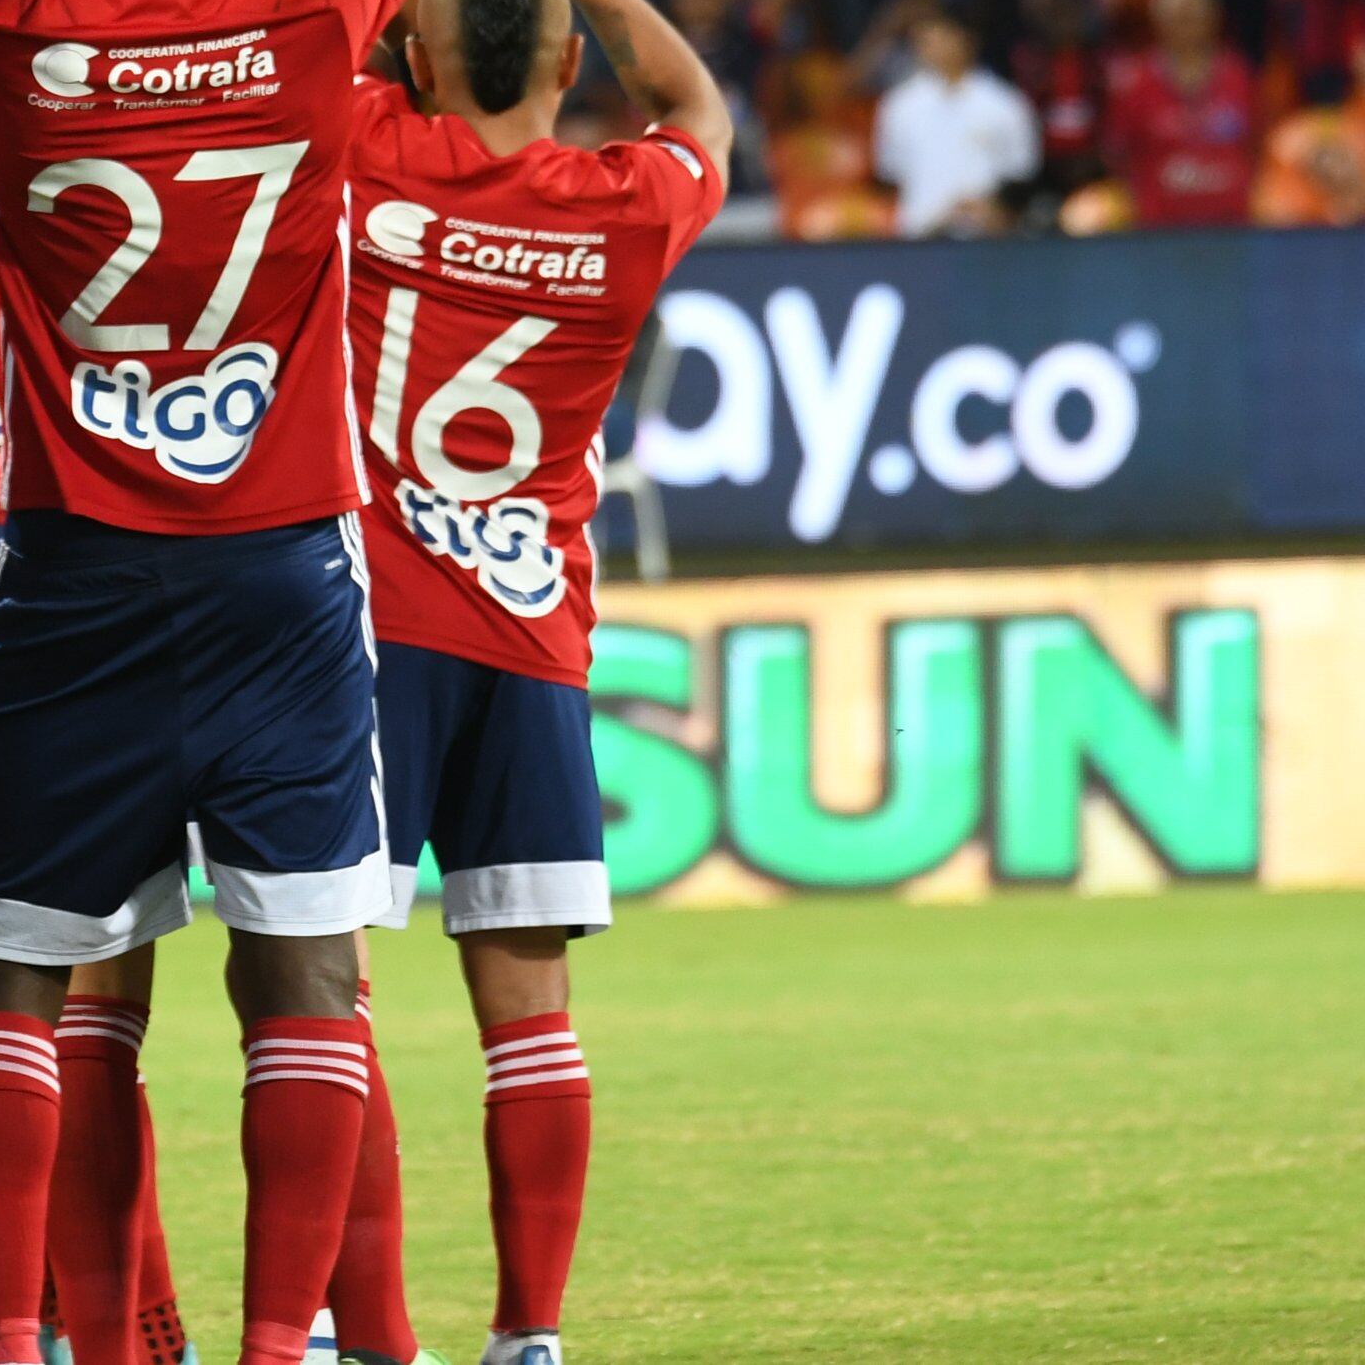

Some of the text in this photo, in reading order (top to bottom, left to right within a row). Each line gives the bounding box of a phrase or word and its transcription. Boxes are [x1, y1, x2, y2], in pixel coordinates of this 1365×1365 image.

[107, 28, 267, 60] COOPERATIVA FINANCIERA
[107, 46, 277, 95] Cotrafa
[222, 82, 281, 103] Facilitar
[27, 141, 310, 352] 27
[439, 231, 607, 281] Cotrafa
[370, 287, 559, 502] 16
